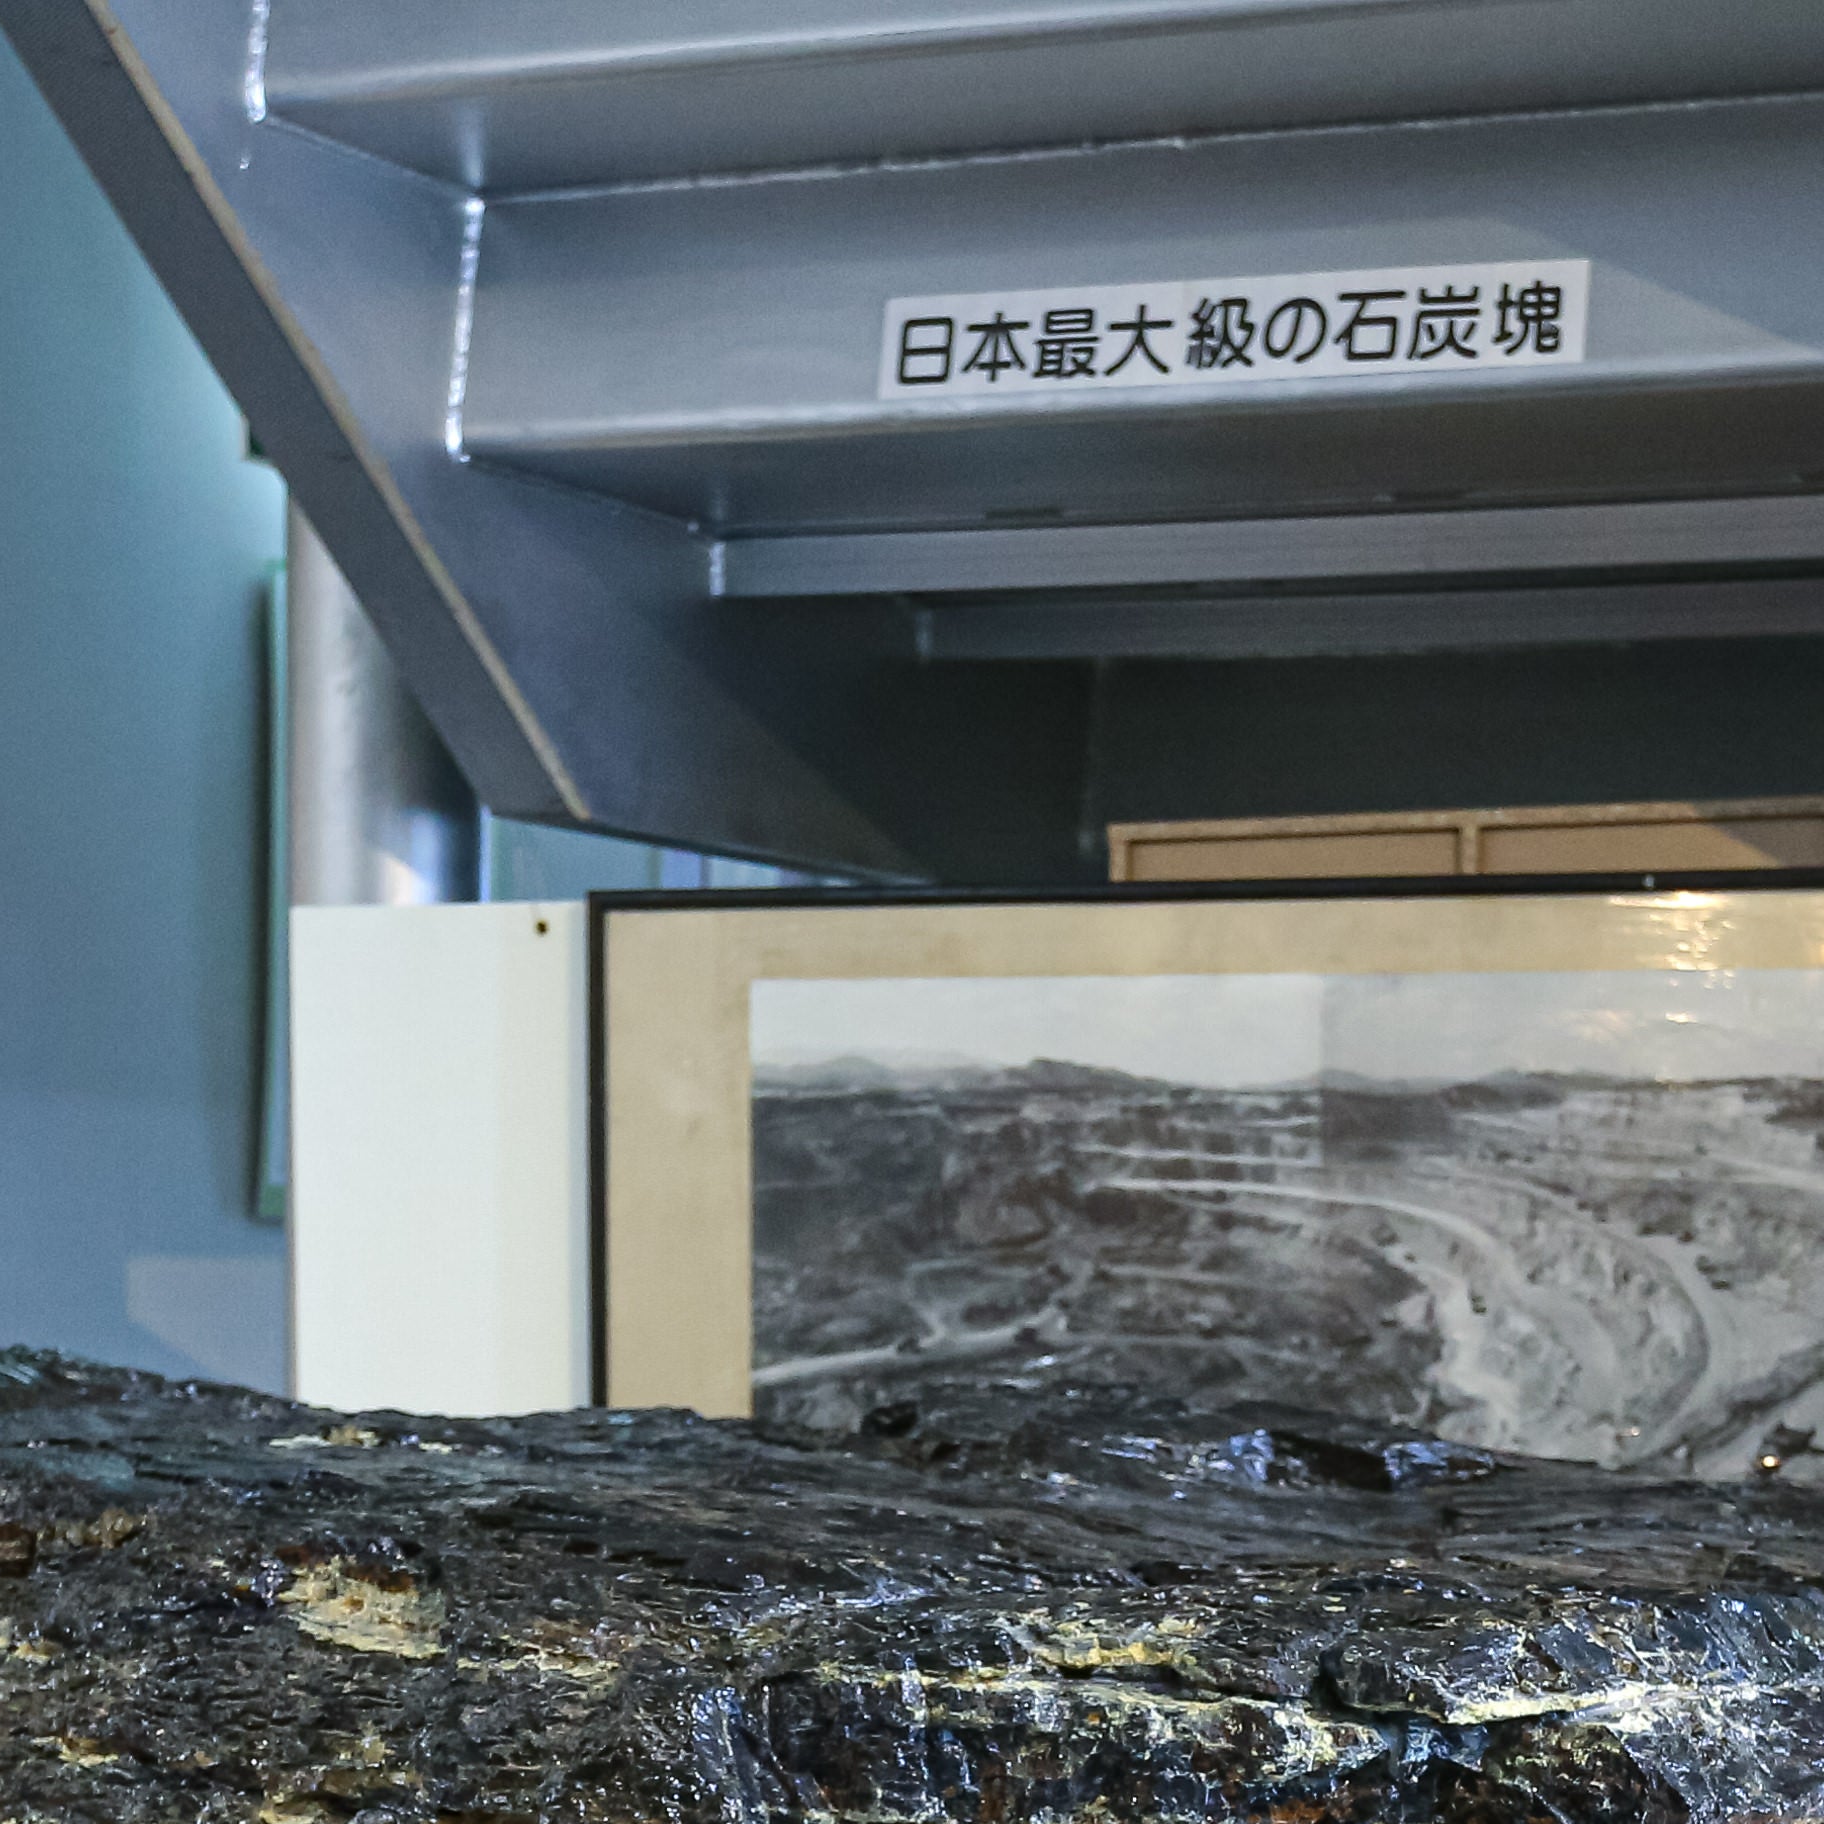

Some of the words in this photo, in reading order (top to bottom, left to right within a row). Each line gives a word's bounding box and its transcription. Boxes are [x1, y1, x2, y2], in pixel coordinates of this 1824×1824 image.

[895, 279, 1563, 387] 日本最大級の石炭塊
